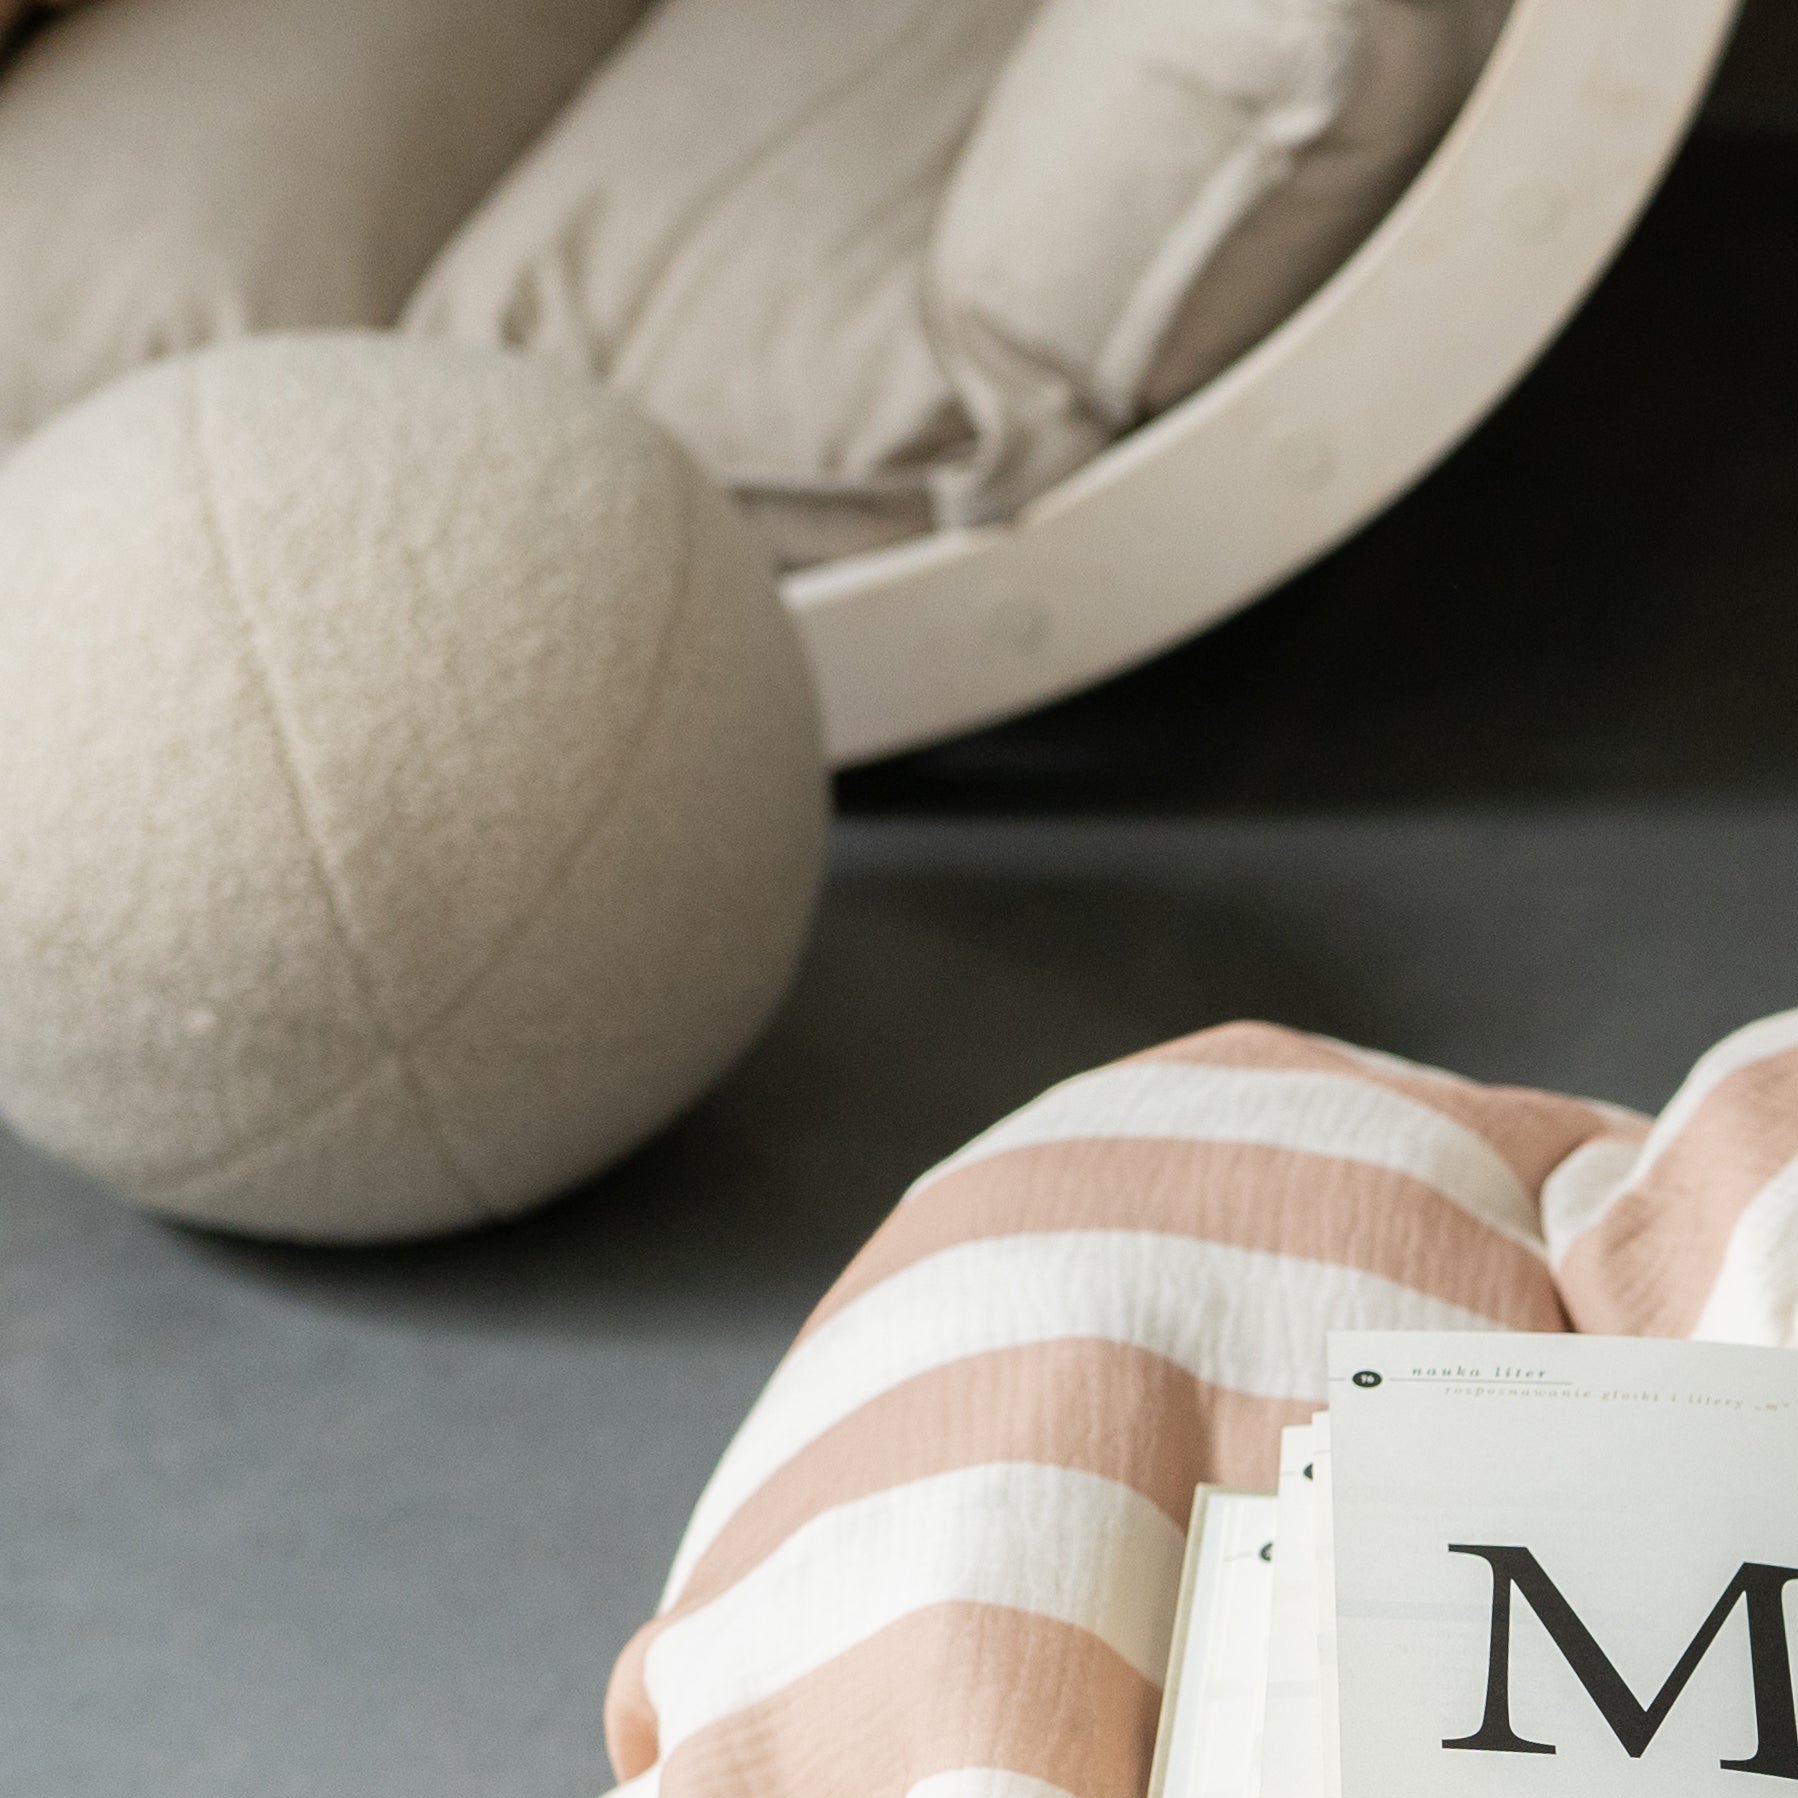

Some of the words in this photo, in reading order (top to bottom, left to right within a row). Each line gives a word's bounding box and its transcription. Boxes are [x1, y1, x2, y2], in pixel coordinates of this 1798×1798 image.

[1411, 1364, 1481, 1379] nauka
[1495, 1365, 1548, 1379] liter
[1444, 1385, 1592, 1400] rozpoznawanie
[1687, 1394, 1745, 1410] litery
